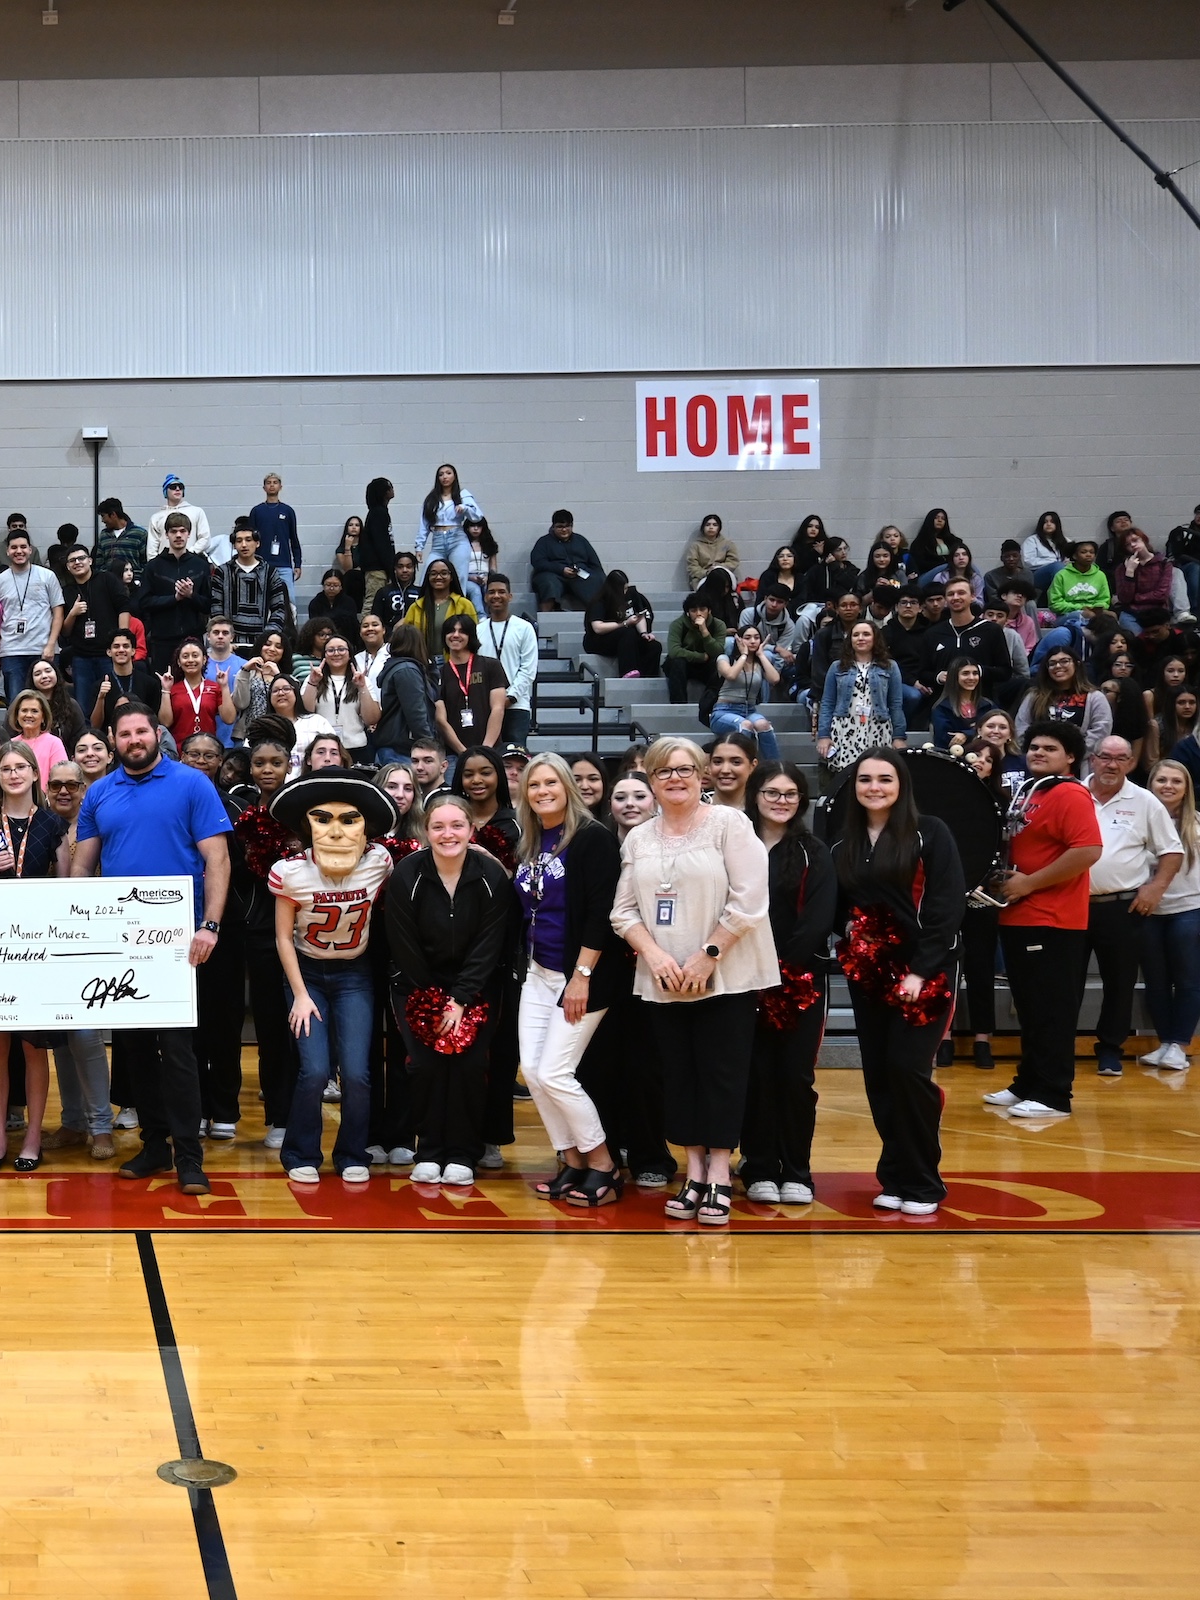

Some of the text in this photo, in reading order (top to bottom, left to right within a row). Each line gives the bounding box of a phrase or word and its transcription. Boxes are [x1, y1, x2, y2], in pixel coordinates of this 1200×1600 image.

[645, 394, 810, 457] HOME
[312, 887, 367, 904] PATRIOTS
[70, 904, 124, 921] May 2024
[303, 899, 371, 950] 23
[121, 932, 129, 943] $
